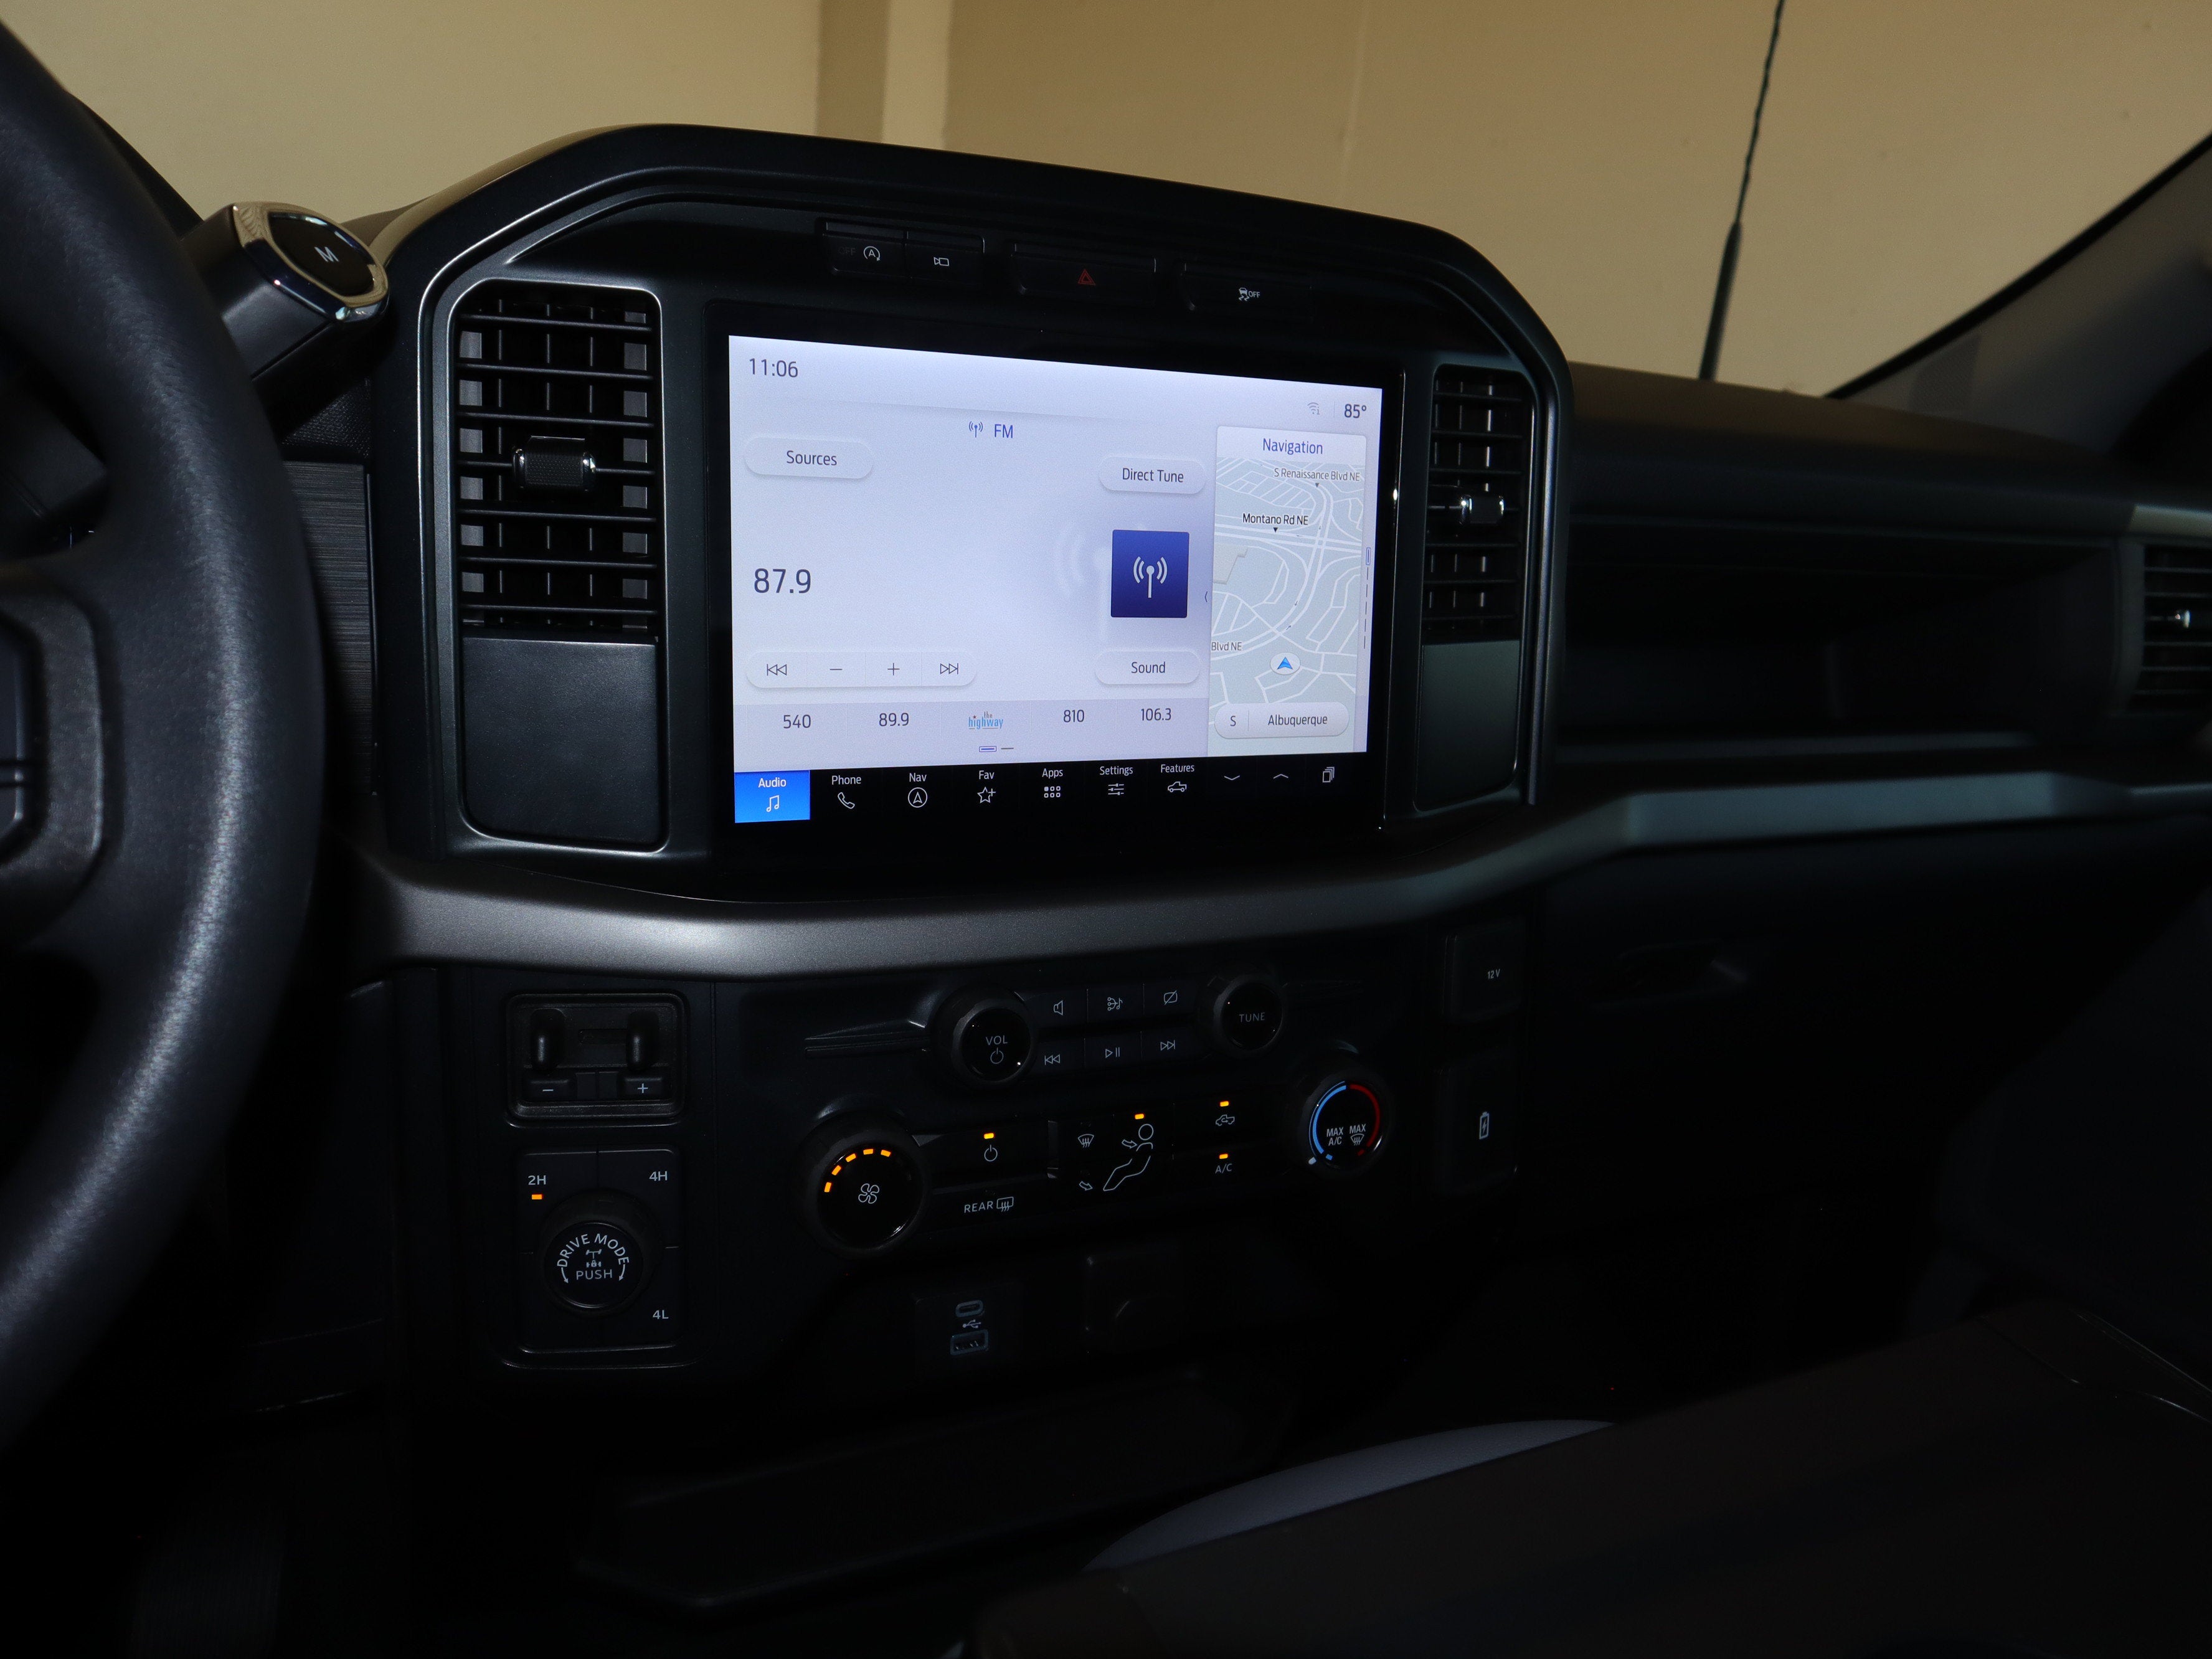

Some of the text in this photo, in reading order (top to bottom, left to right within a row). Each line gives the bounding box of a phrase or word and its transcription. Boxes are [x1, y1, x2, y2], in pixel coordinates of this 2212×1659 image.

[314, 247, 339, 262] M
[749, 357, 799, 378] 11:06
[1343, 403, 1367, 418] 85°
[994, 423, 1014, 438] FM
[1262, 438, 1323, 455] Navigation
[786, 450, 837, 466] Sources
[1122, 467, 1184, 483] Direct Tune
[1274, 468, 1361, 481] S Renaissance Blvd NE
[1242, 513, 1309, 525] Montano Rd NE
[753, 567, 811, 594] 87.9
[1211, 641, 1242, 651] Blvd NE
[1131, 661, 1166, 674] Sound
[879, 712, 910, 727] 89.9
[984, 711, 993, 719] the
[1063, 709, 1085, 723] 810
[1140, 707, 1171, 721] 106.3
[783, 714, 811, 729] 540
[968, 715, 1004, 730] highway
[1230, 716, 1236, 727] S
[1267, 714, 1328, 727] Albuquerque
[1042, 768, 1064, 779] Apps
[1100, 765, 1133, 777] Settings
[1161, 763, 1194, 773] Features
[831, 774, 862, 786] Phone
[909, 772, 927, 783] Nav
[979, 770, 995, 780] Fav
[758, 777, 787, 788] Audio
[1239, 1011, 1265, 1023] TUNE
[986, 1035, 1008, 1045] VOL
[1326, 1126, 1344, 1137] MAX
[1349, 1123, 1366, 1134] MAX
[1328, 1136, 1343, 1146] A/C
[1215, 1162, 1233, 1174] A/C
[527, 1175, 547, 1185] 2H
[649, 1170, 668, 1181] 4H
[963, 1200, 994, 1214] REAR
[557, 1232, 630, 1268] DRIVE MODE
[575, 1269, 613, 1280] PUSH
[652, 1310, 669, 1320] 4L
